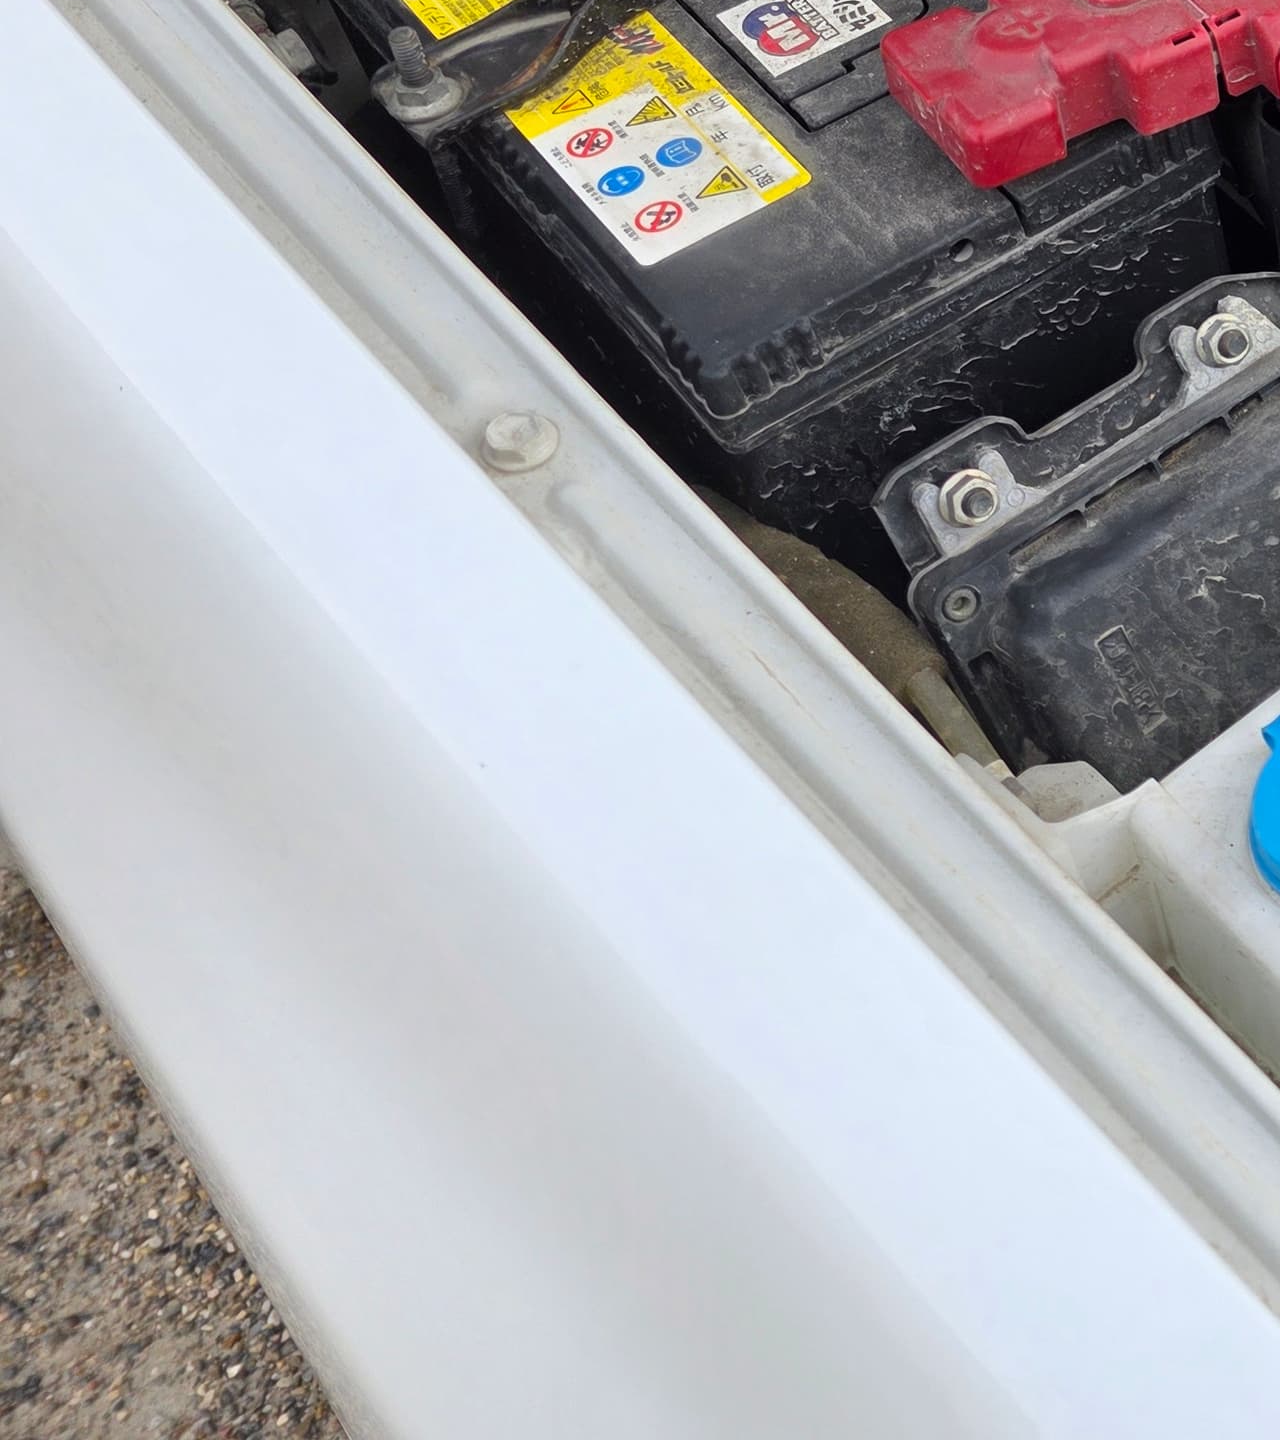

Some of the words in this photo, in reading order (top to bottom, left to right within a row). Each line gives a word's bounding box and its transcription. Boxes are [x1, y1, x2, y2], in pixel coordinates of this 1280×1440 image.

[749, 2, 811, 53] Mr.
[683, 101, 706, 118] 月
[703, 91, 729, 113] km
[708, 127, 731, 144] 年
[744, 162, 776, 188] 取付
